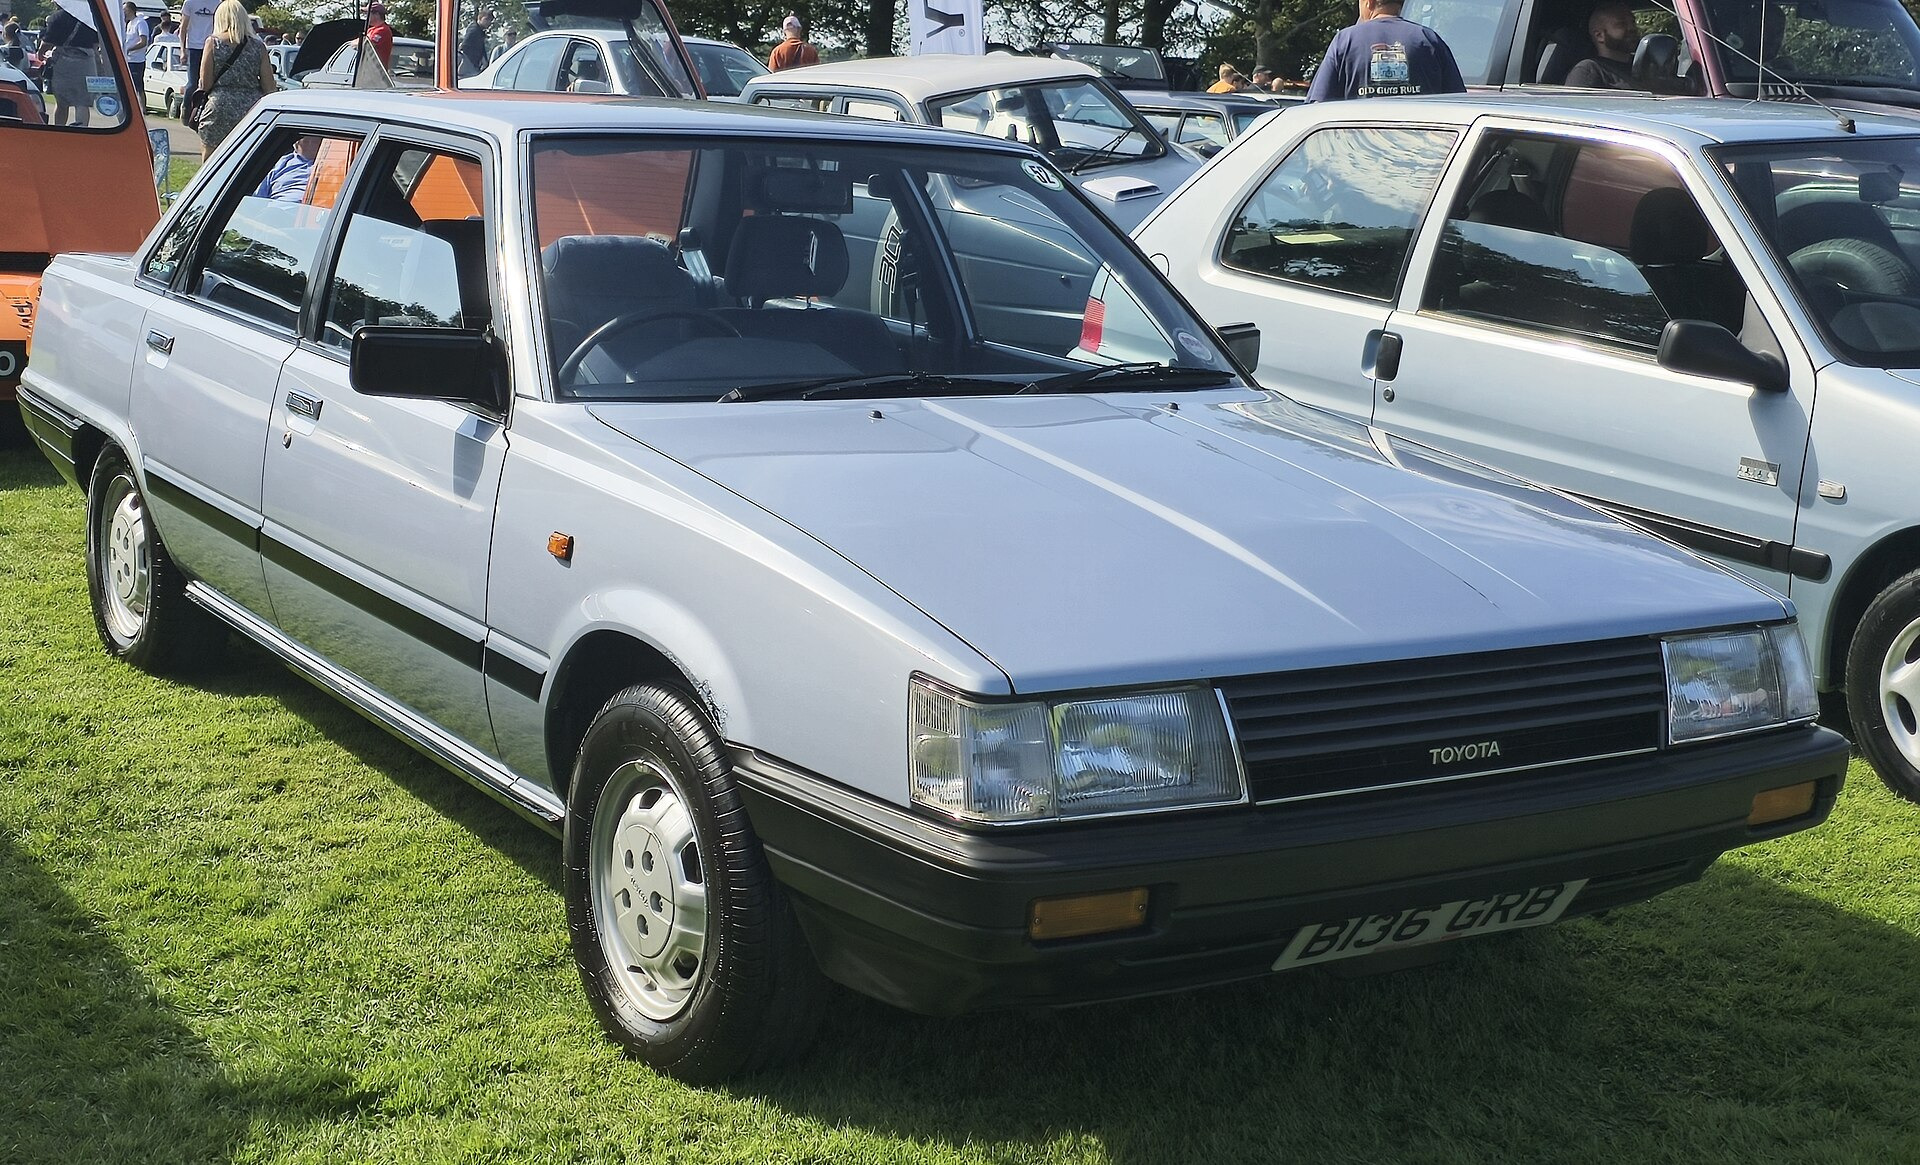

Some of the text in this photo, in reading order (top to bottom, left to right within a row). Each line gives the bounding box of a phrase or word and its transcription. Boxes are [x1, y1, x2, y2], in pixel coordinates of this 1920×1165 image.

[1358, 85, 1421, 96] OLD GUYS RULE
[1029, 165, 1056, 184] 52
[1429, 741, 1501, 765] TOYOTA
[1296, 883, 1565, 960] B136 GRB
